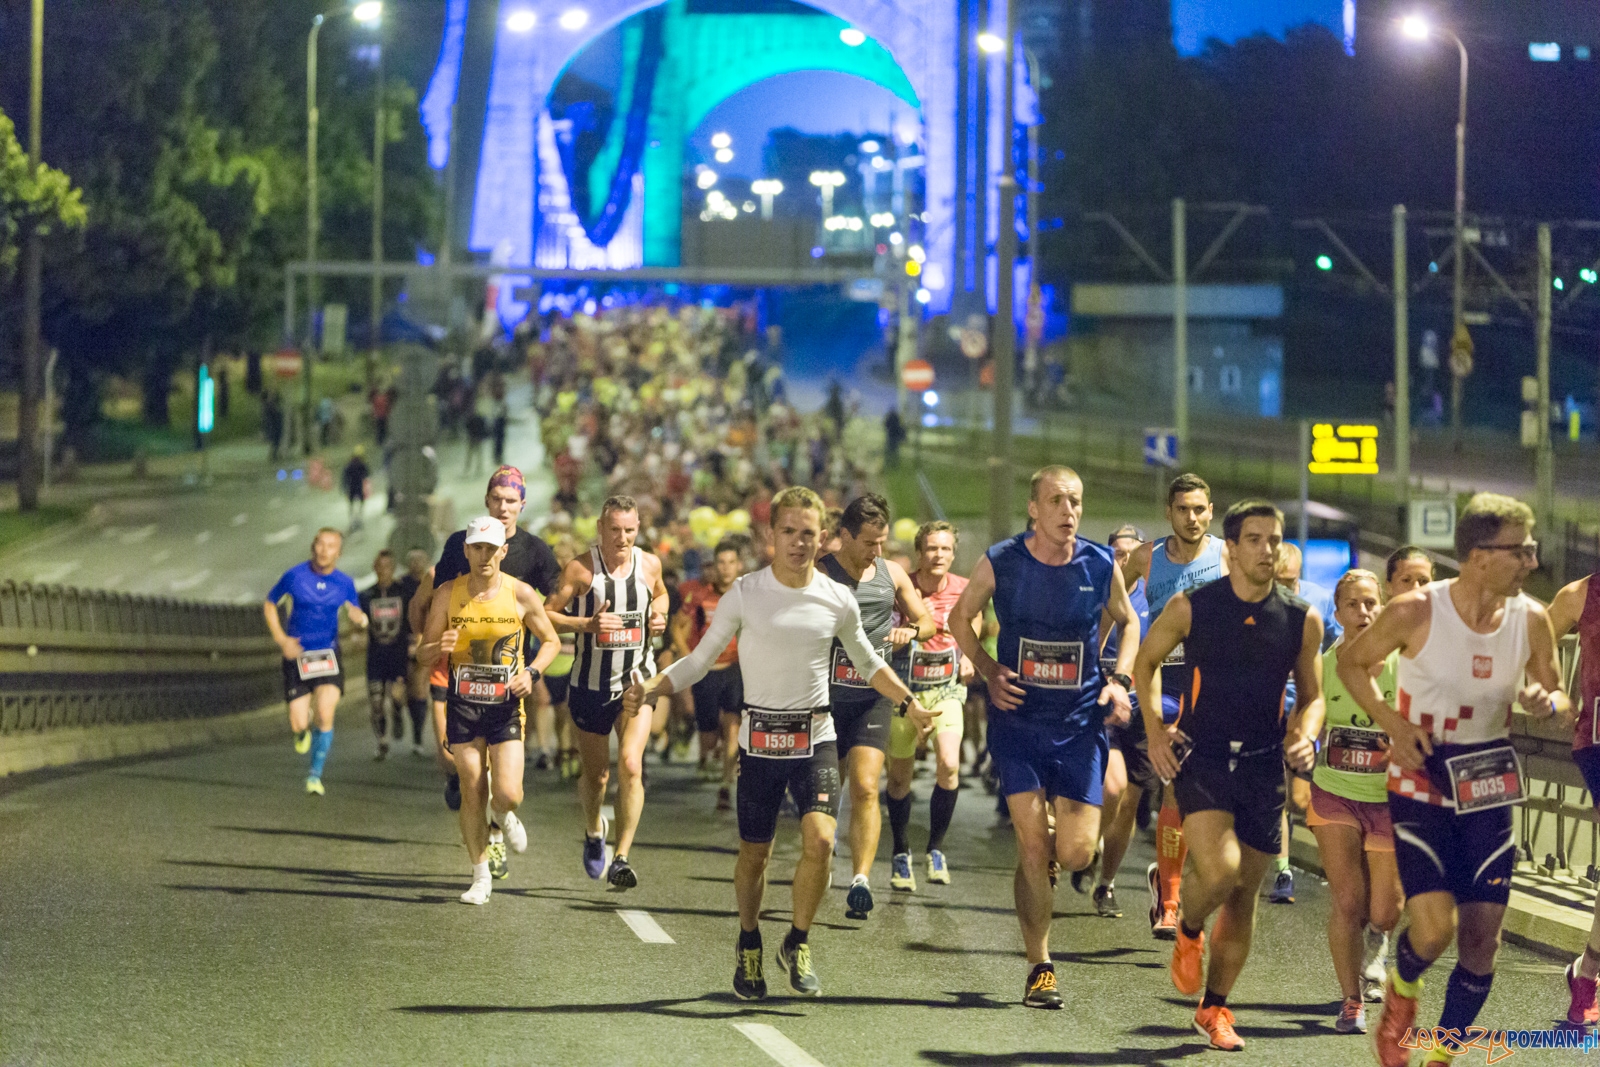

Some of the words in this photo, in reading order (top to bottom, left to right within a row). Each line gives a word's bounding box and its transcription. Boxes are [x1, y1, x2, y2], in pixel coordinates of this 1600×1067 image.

[480, 616, 516, 624] POLSKA
[609, 630, 632, 642] 1884
[469, 683, 496, 695] 2930
[764, 734, 796, 749] 1536
[1341, 749, 1372, 766] 2167
[1471, 775, 1505, 798] 6035
